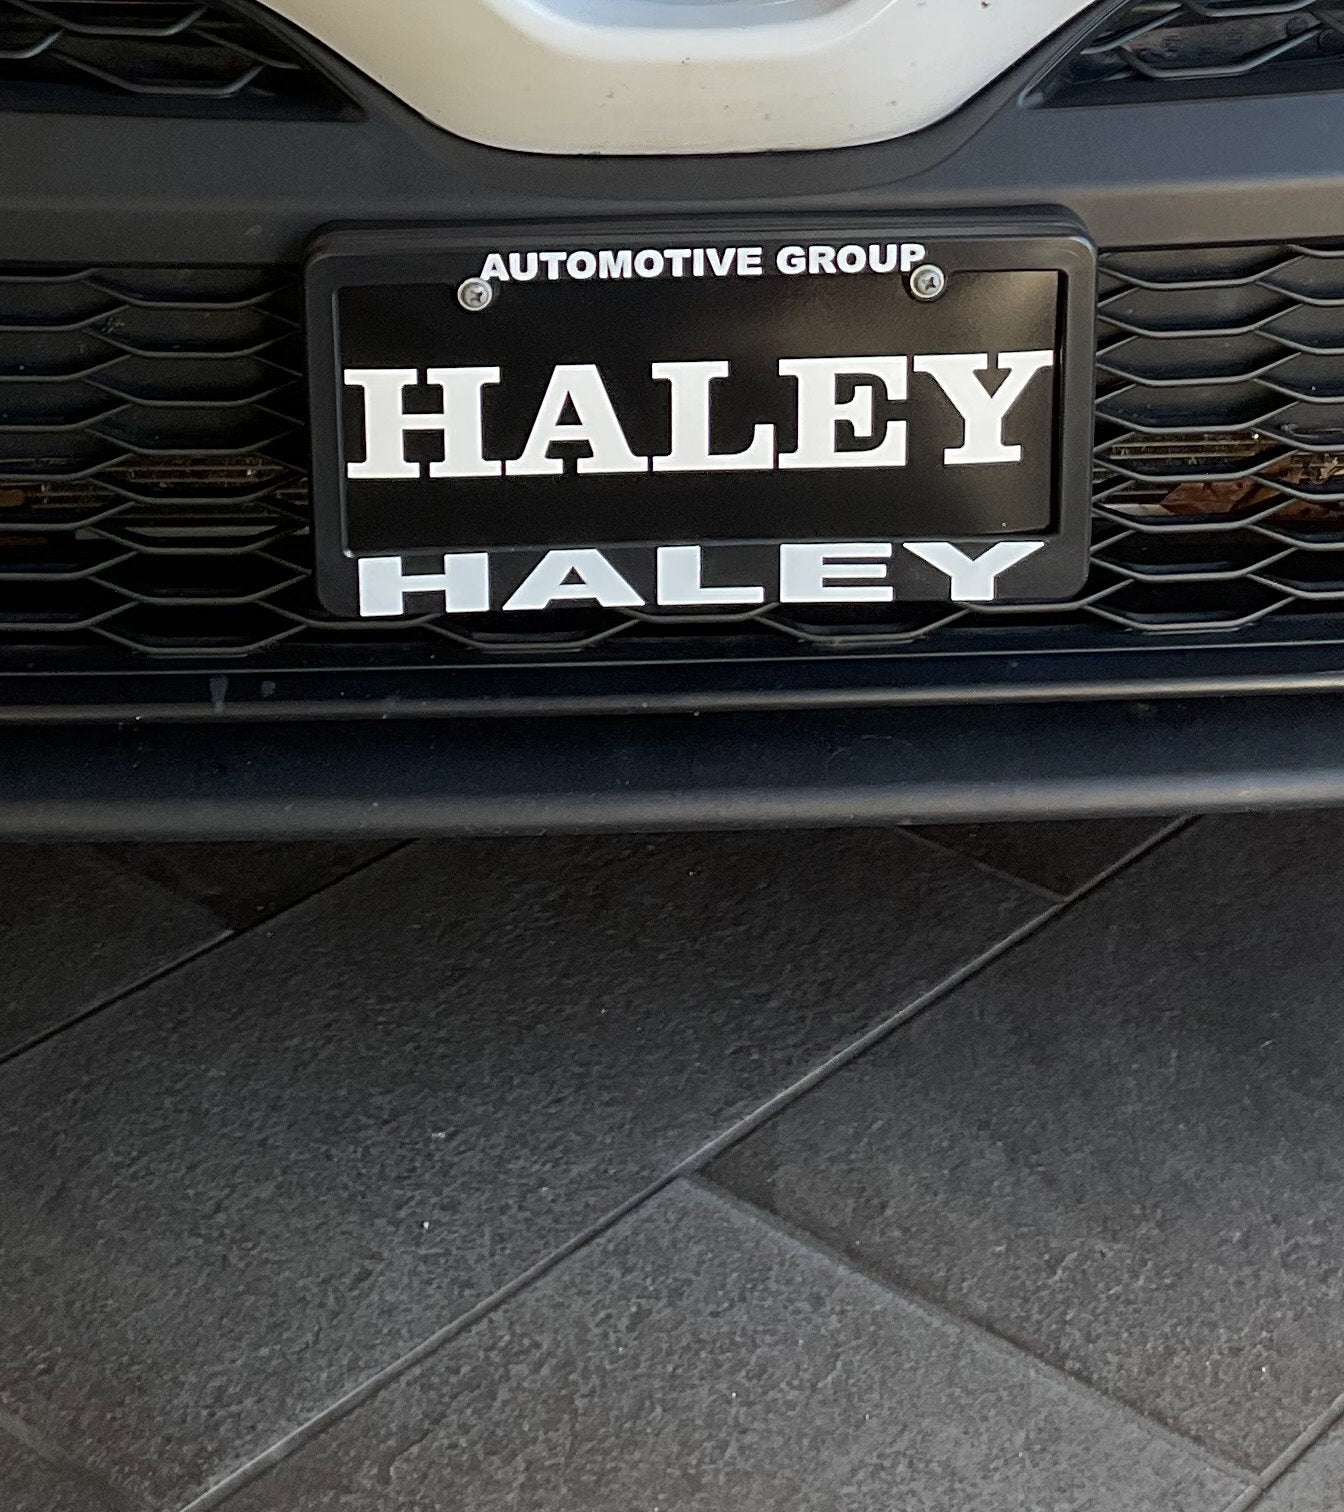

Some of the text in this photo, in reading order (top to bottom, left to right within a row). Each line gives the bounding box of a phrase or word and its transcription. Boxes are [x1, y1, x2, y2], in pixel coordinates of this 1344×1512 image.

[480, 243, 926, 281] AUTOMOTIVE GROUP
[343, 349, 1055, 479] HALEY
[358, 541, 1046, 616] HALEY
